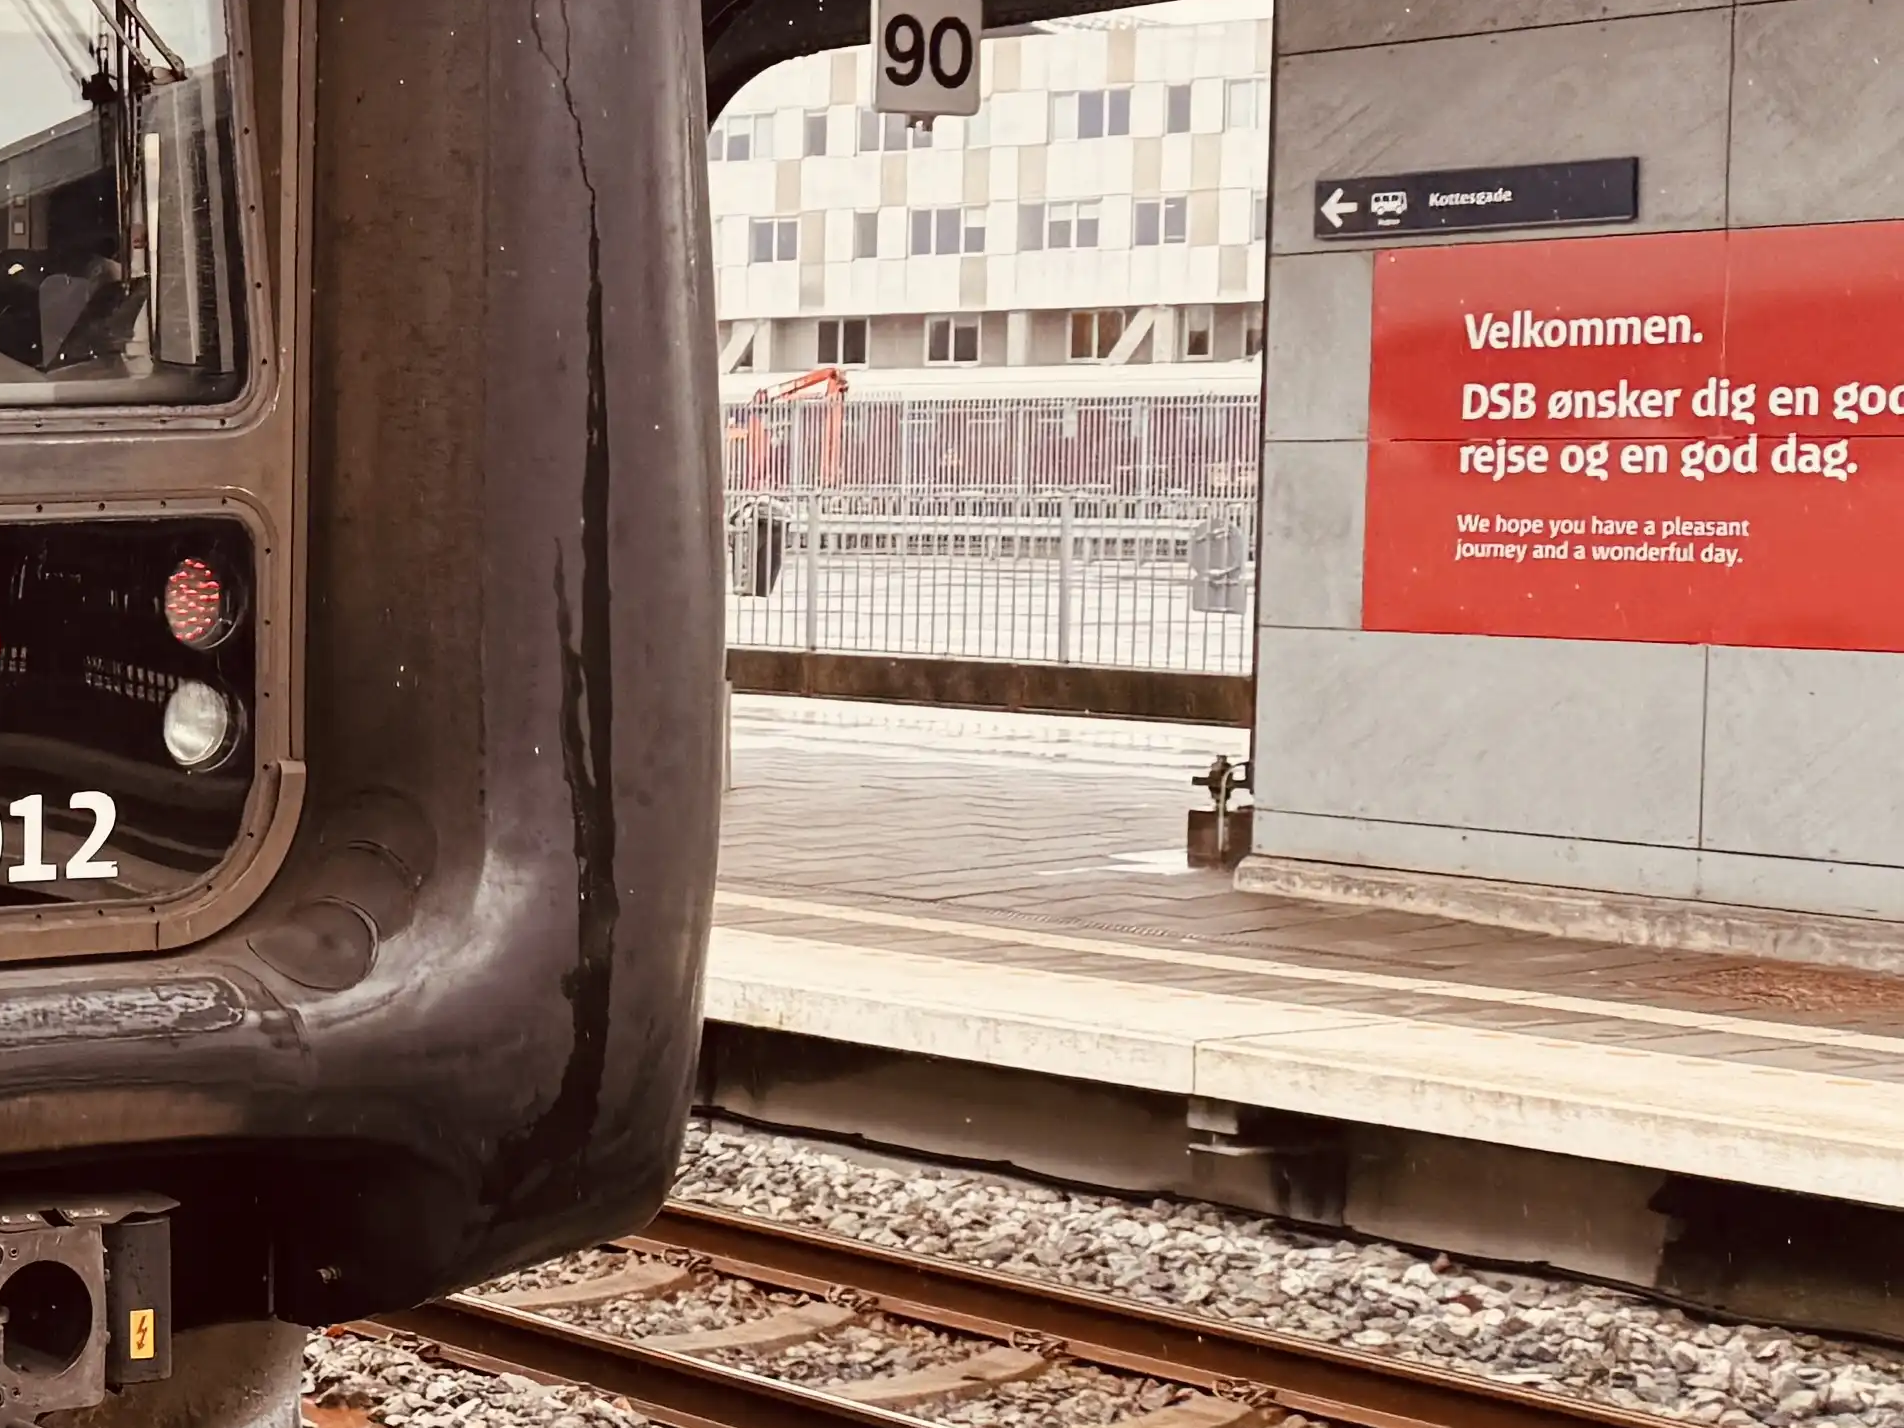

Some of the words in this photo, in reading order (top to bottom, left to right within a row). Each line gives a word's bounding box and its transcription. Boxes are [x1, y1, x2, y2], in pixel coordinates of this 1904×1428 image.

[885, 14, 972, 88] 90
[1465, 310, 1702, 349] Velkommen.
[1463, 383, 1536, 419] DSB
[1548, 380, 1681, 419] ønsker
[1692, 377, 1755, 424] dig
[1769, 387, 1818, 416] en
[1460, 439, 1548, 481] rejse
[1561, 441, 1608, 481] og
[1621, 445, 1667, 473] en
[1681, 434, 1757, 481] god
[1771, 433, 1857, 481] dag.
[1457, 514, 1490, 532] We
[1496, 515, 1543, 536] hope
[1549, 520, 1585, 538] you
[1592, 516, 1638, 535] have
[1644, 521, 1655, 535] a
[1662, 517, 1749, 539] pleasant
[1455, 539, 1527, 562] journey
[1533, 541, 1568, 559] and
[1574, 545, 1585, 559] a
[1592, 542, 1694, 561] wonderful
[1701, 543, 1742, 567] day.
